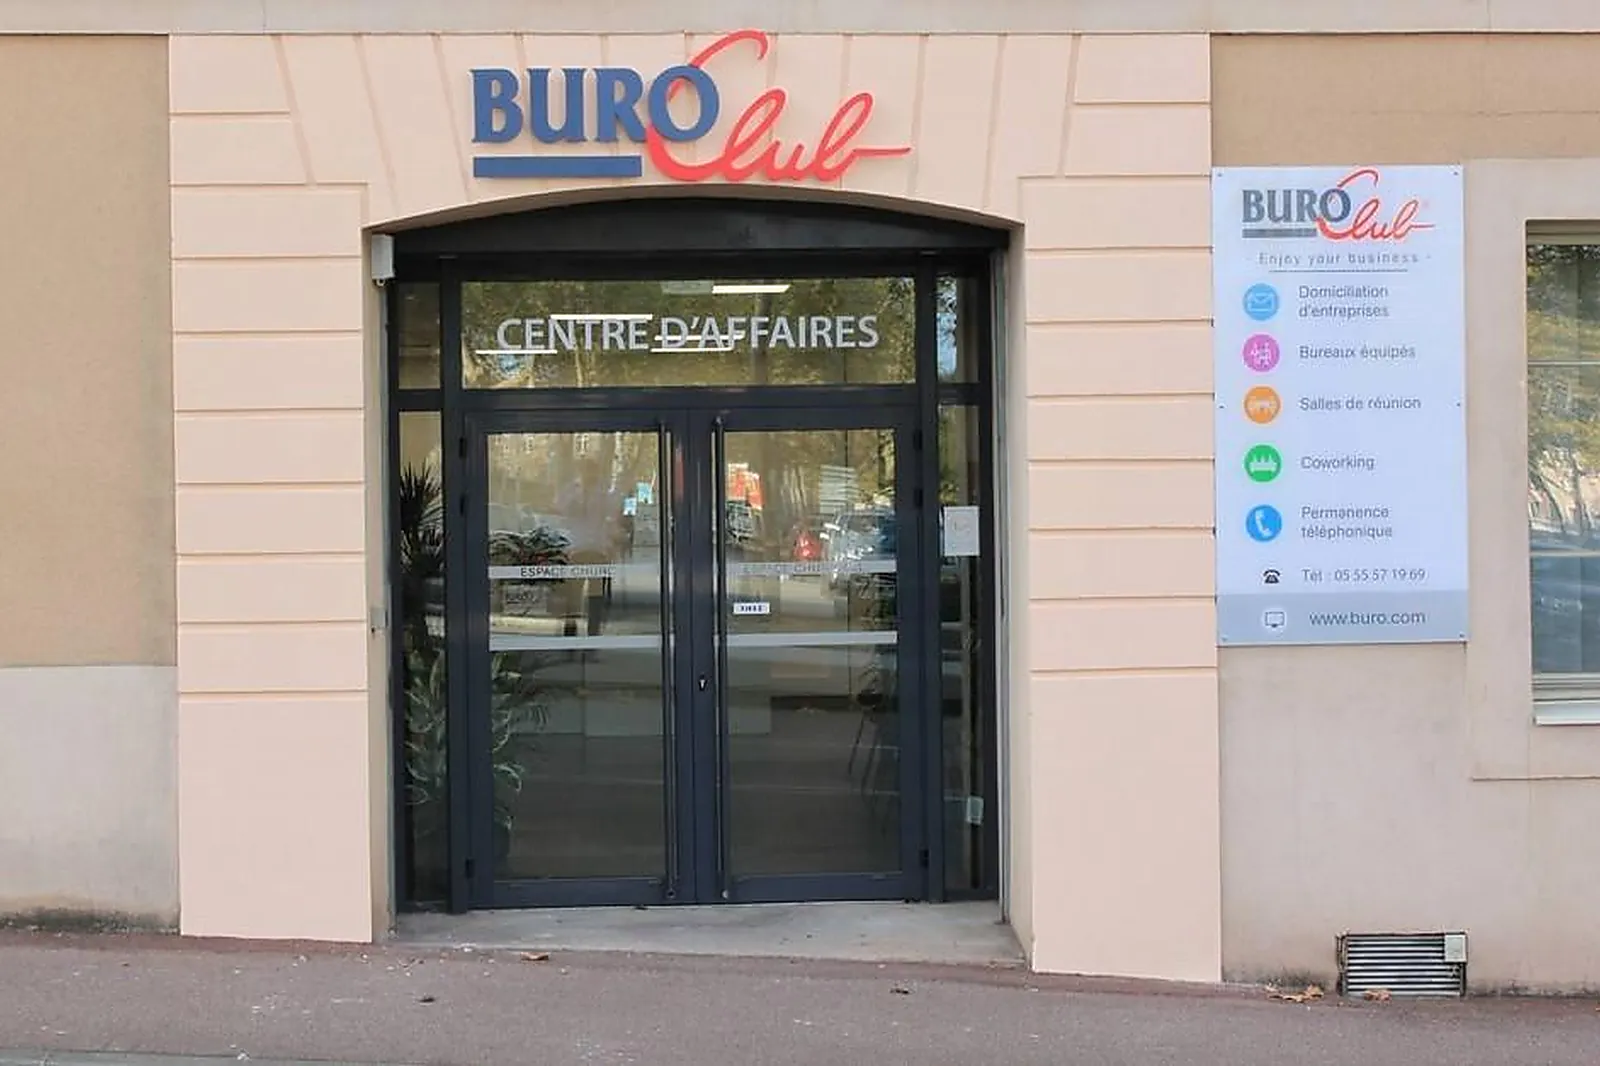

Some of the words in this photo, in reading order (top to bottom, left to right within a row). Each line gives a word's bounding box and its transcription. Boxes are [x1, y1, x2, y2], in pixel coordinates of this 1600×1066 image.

[469, 65, 720, 144] BURO
[646, 30, 911, 181] Club
[1242, 188, 1351, 223] BURO
[1316, 169, 1435, 240] Club
[1258, 252, 1300, 267] Enjoy
[1308, 253, 1340, 267] your
[1348, 251, 1419, 264] business
[1299, 284, 1389, 299] Domiciliation
[1299, 304, 1390, 320] d'entreprises
[496, 315, 649, 351] CENTRE
[661, 315, 879, 350] D'AFFAIRES
[1299, 345, 1356, 359] Bureaux
[1360, 343, 1416, 361] équipés
[1299, 397, 1341, 410] Salles
[1345, 397, 1363, 410] de
[1367, 395, 1421, 409] réunion
[1300, 455, 1376, 471] Coworking
[1301, 505, 1390, 519] Permanence
[1301, 524, 1393, 540] téléphonique
[519, 566, 565, 578] ESPACE
[1334, 568, 1350, 581] 05
[1353, 568, 1370, 581] 55
[1392, 568, 1407, 580] 19
[1409, 567, 1426, 580] 69
[1309, 610, 1427, 626] www.buro.com
